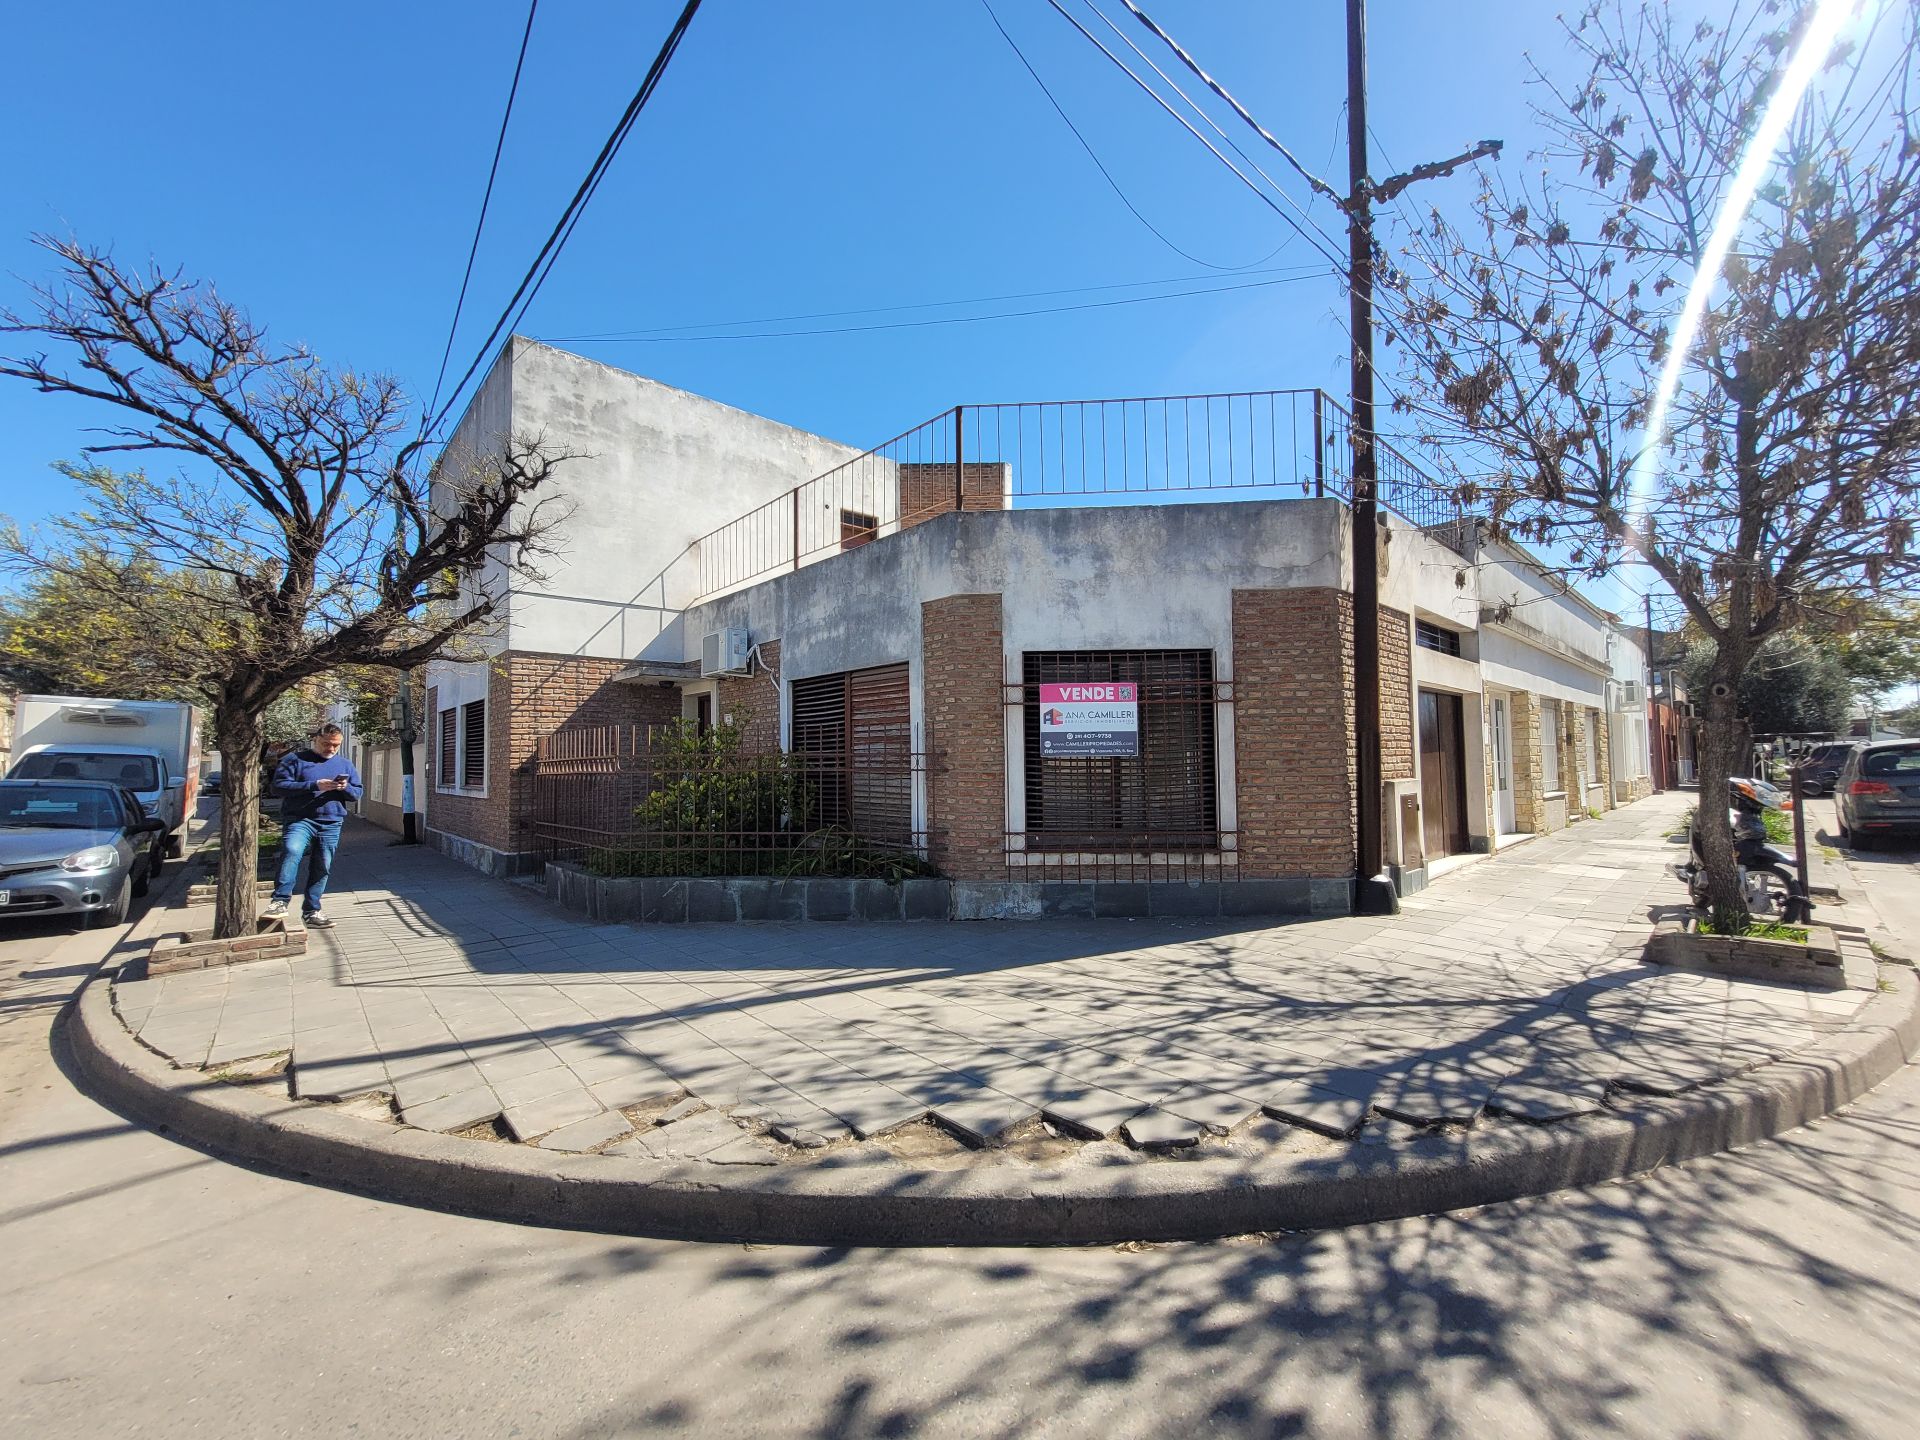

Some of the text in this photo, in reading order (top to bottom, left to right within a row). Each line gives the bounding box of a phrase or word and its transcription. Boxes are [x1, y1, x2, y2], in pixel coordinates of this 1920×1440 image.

[1059, 687, 1114, 700] VENDE
[1065, 710, 1135, 719] ANA CAMILLERI
